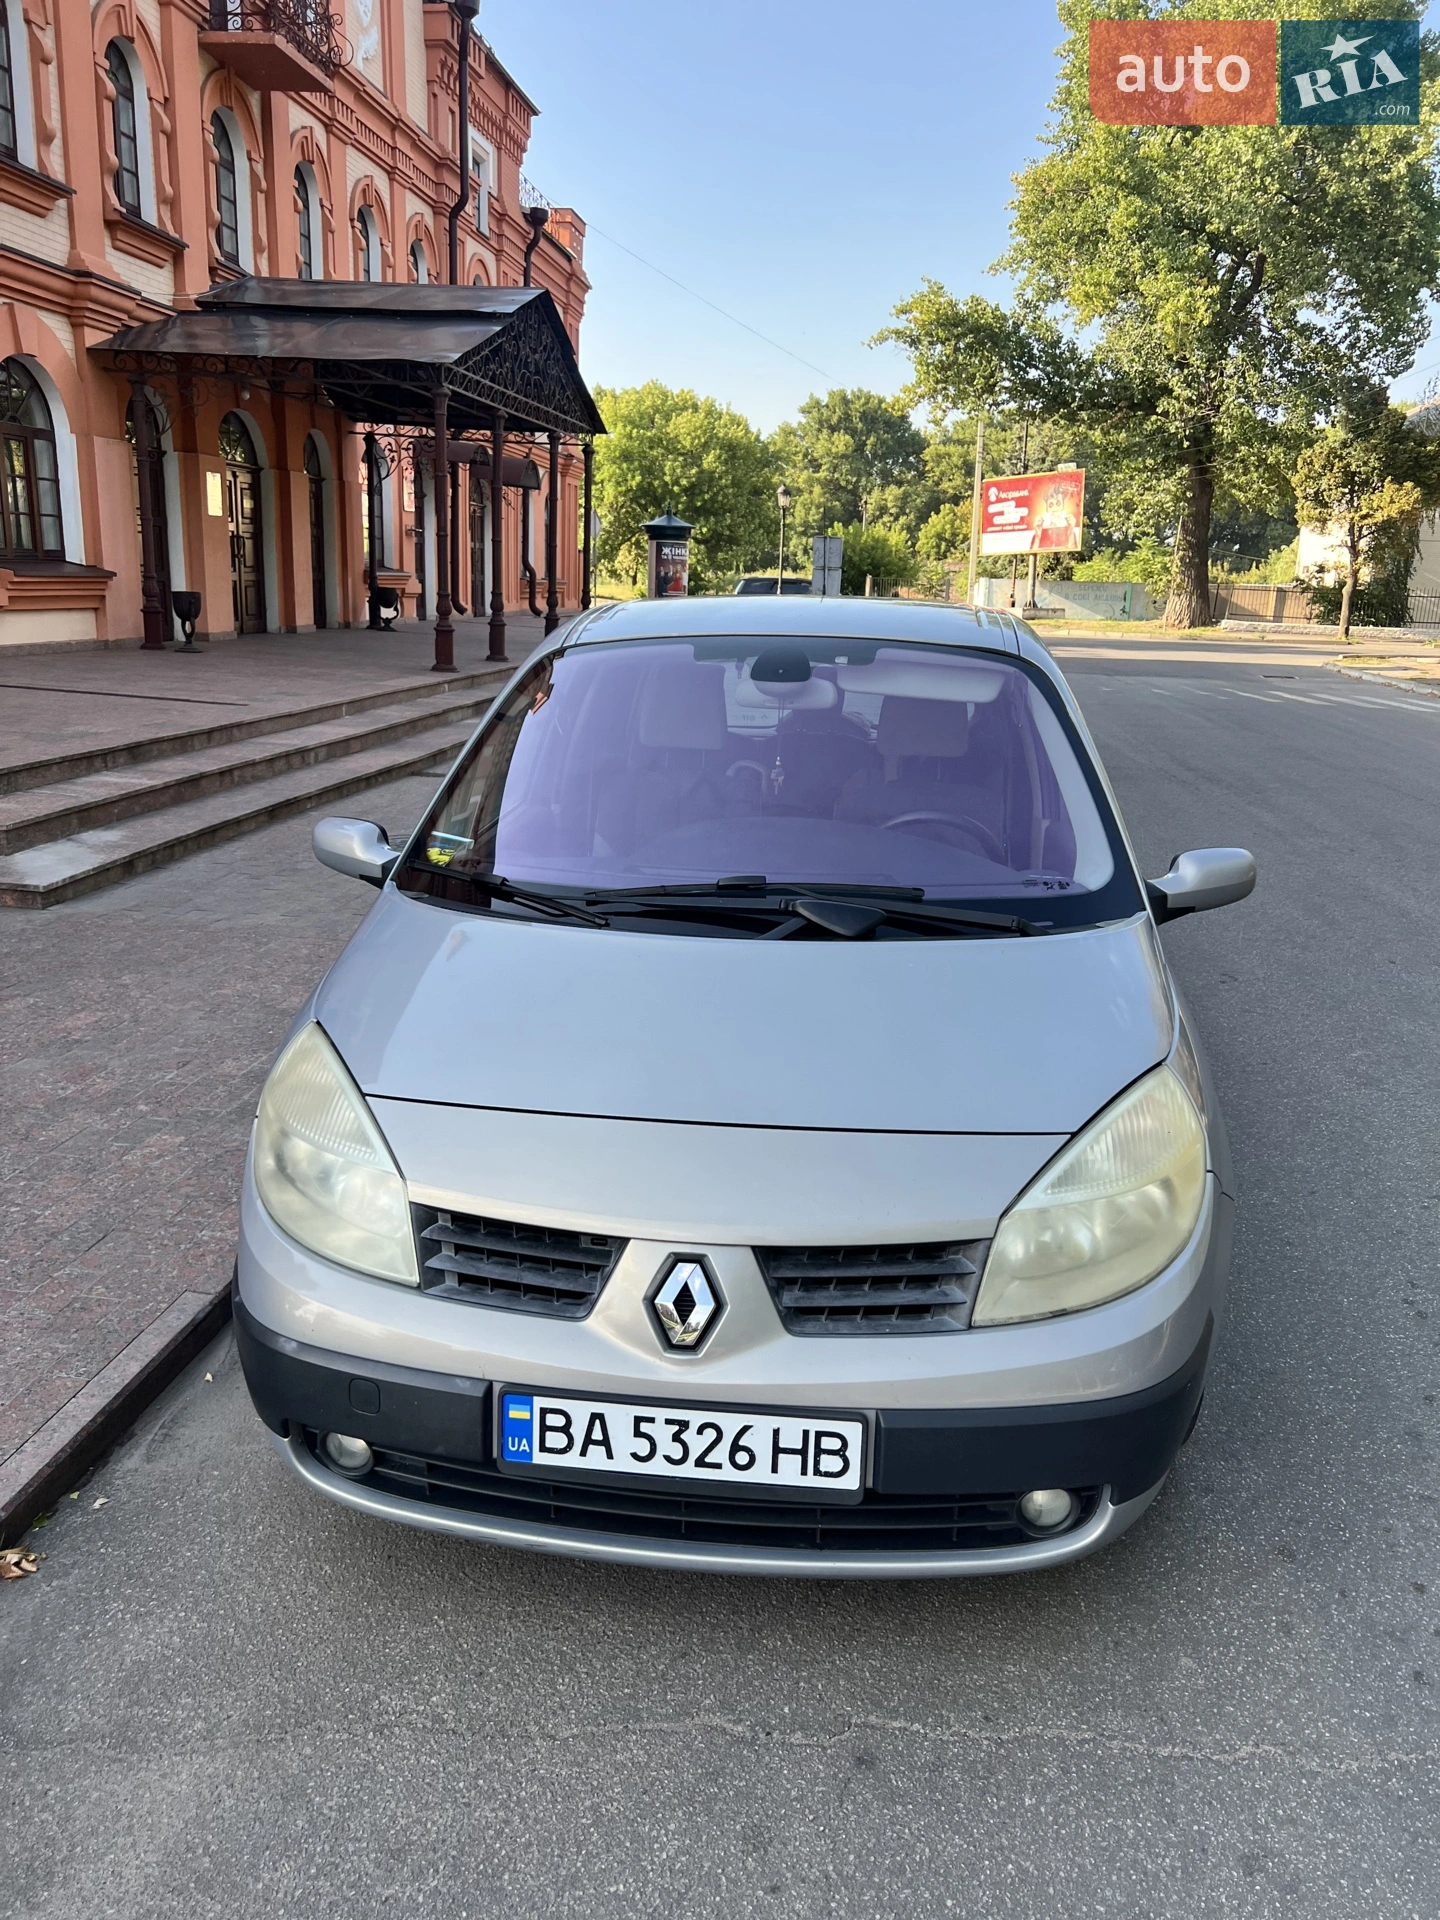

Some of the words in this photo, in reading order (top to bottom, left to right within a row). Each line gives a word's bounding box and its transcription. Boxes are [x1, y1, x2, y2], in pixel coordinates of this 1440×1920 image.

[661, 546, 688, 556] ЖІНК
[508, 1436, 531, 1453] UA
[538, 1406, 615, 1461] BA
[629, 1415, 757, 1472] 5326
[770, 1426, 851, 1479] HB
